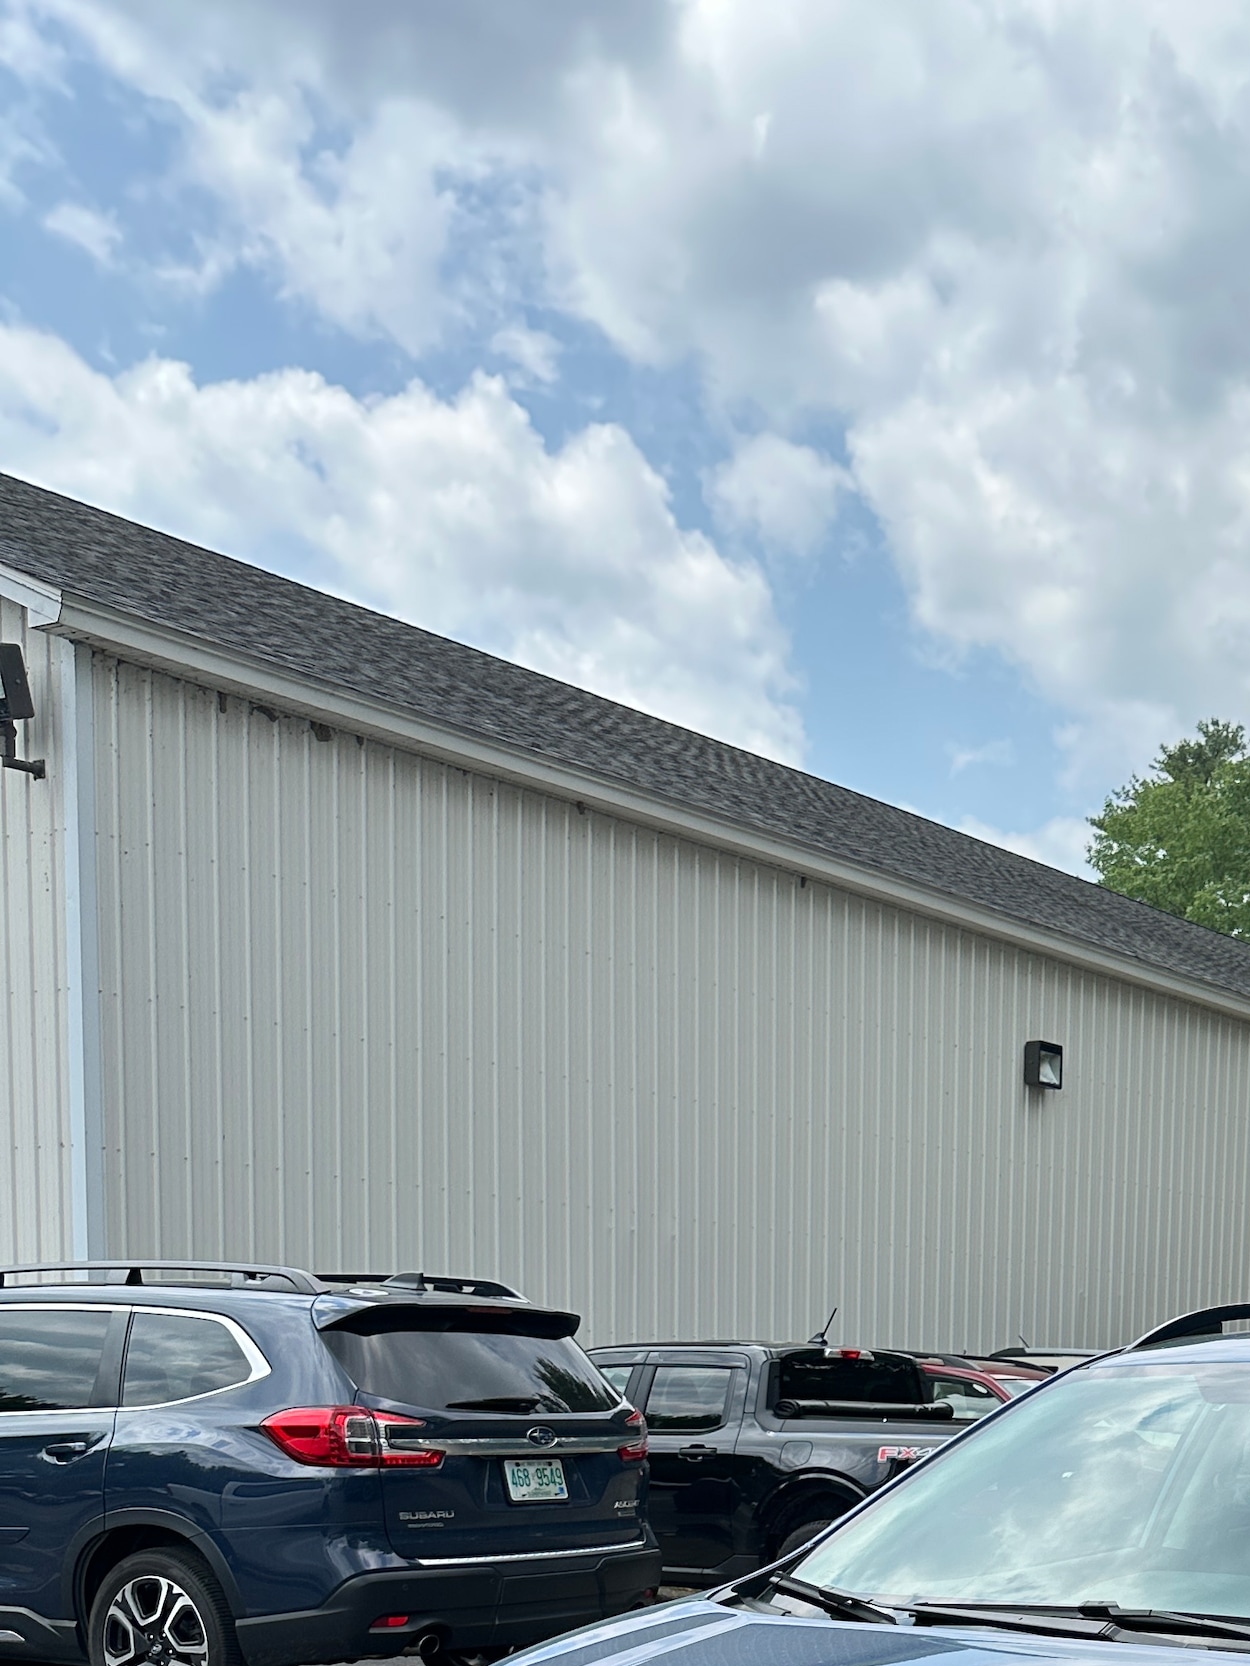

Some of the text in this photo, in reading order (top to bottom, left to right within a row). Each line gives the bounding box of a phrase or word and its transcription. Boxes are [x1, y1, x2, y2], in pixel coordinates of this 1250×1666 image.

[511, 1467, 564, 1487] 468 9549
[399, 1510, 455, 1520] SUBARU
